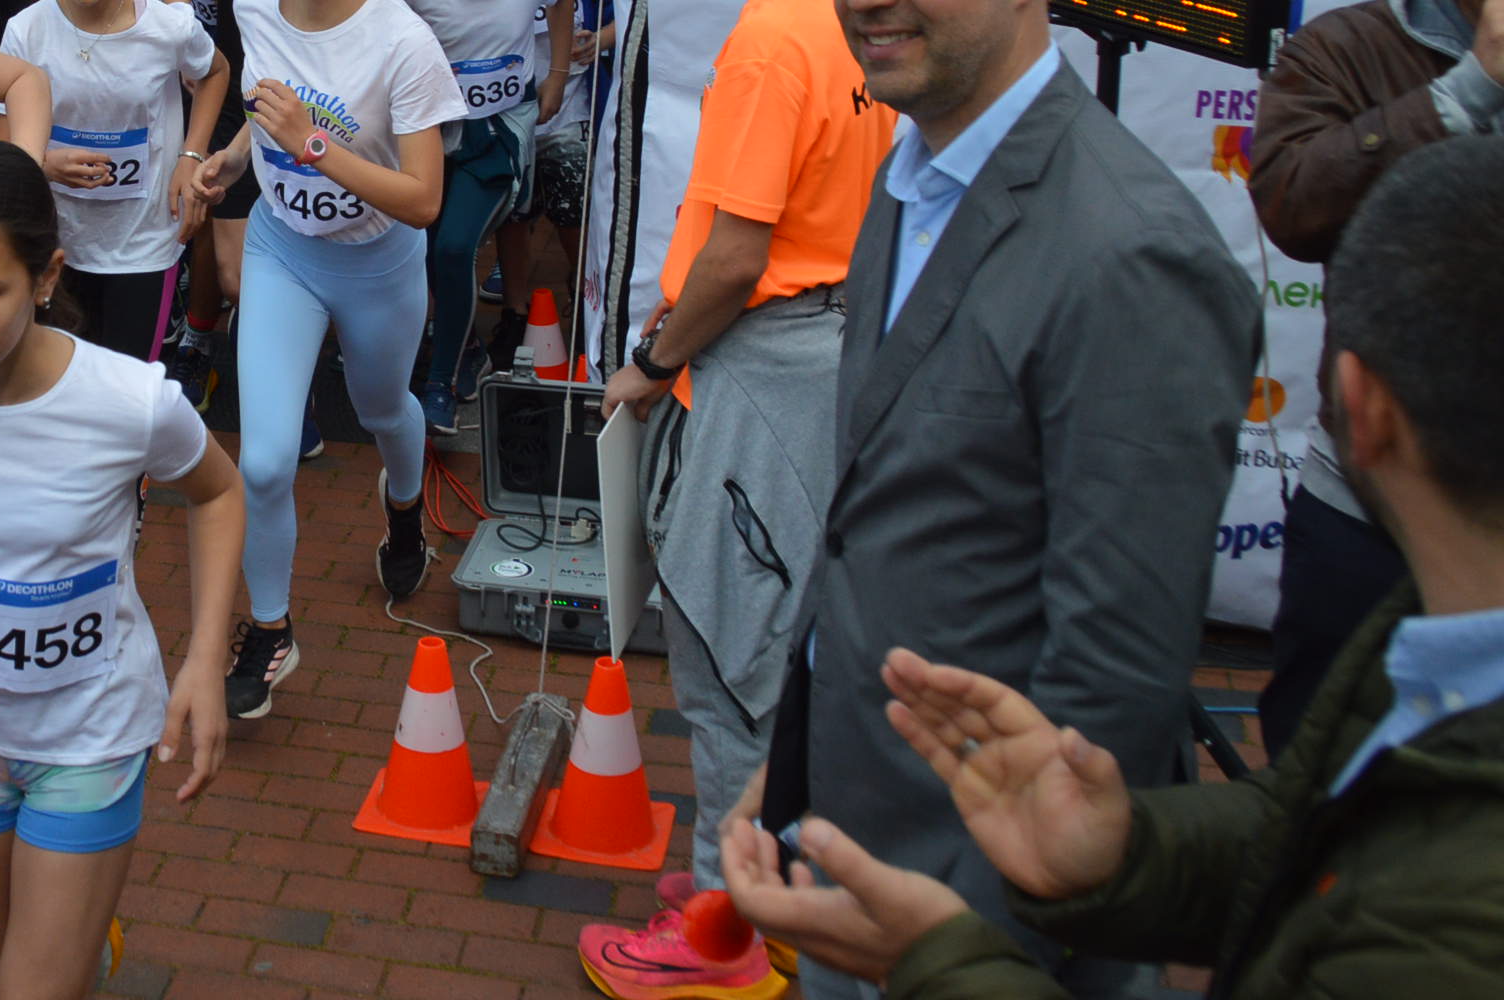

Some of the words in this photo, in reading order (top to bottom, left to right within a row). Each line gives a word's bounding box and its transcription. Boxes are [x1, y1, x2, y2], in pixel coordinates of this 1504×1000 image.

[285, 80, 361, 134] arathon
[462, 75, 520, 108] 636
[1195, 89, 1258, 121] PERS
[307, 106, 354, 144] Varna
[7, 579, 74, 595] DECATHLON
[560, 568, 606, 577] MYLAP
